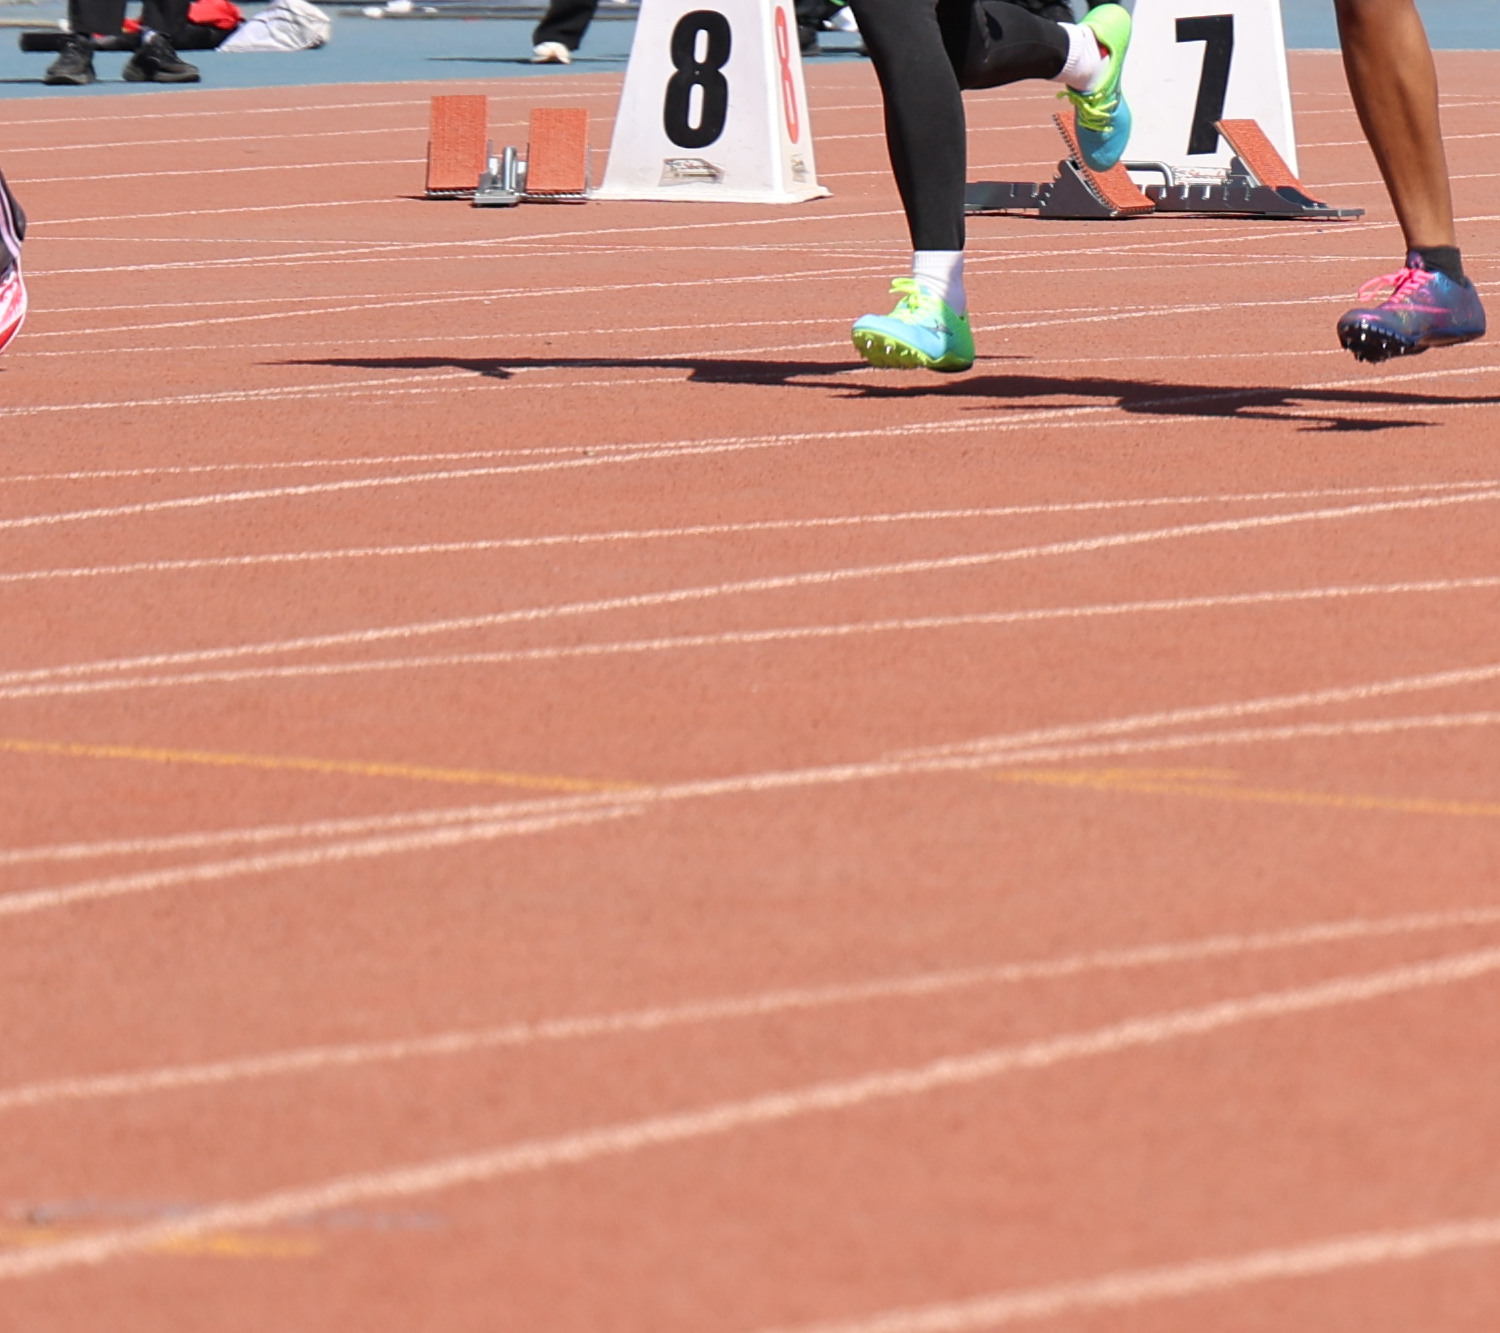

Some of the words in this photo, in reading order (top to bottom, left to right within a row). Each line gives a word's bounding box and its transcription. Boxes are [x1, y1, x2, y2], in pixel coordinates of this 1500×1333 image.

[663, 9, 732, 149] 8
[775, 6, 798, 144] 8
[1175, 14, 1234, 155] 7
